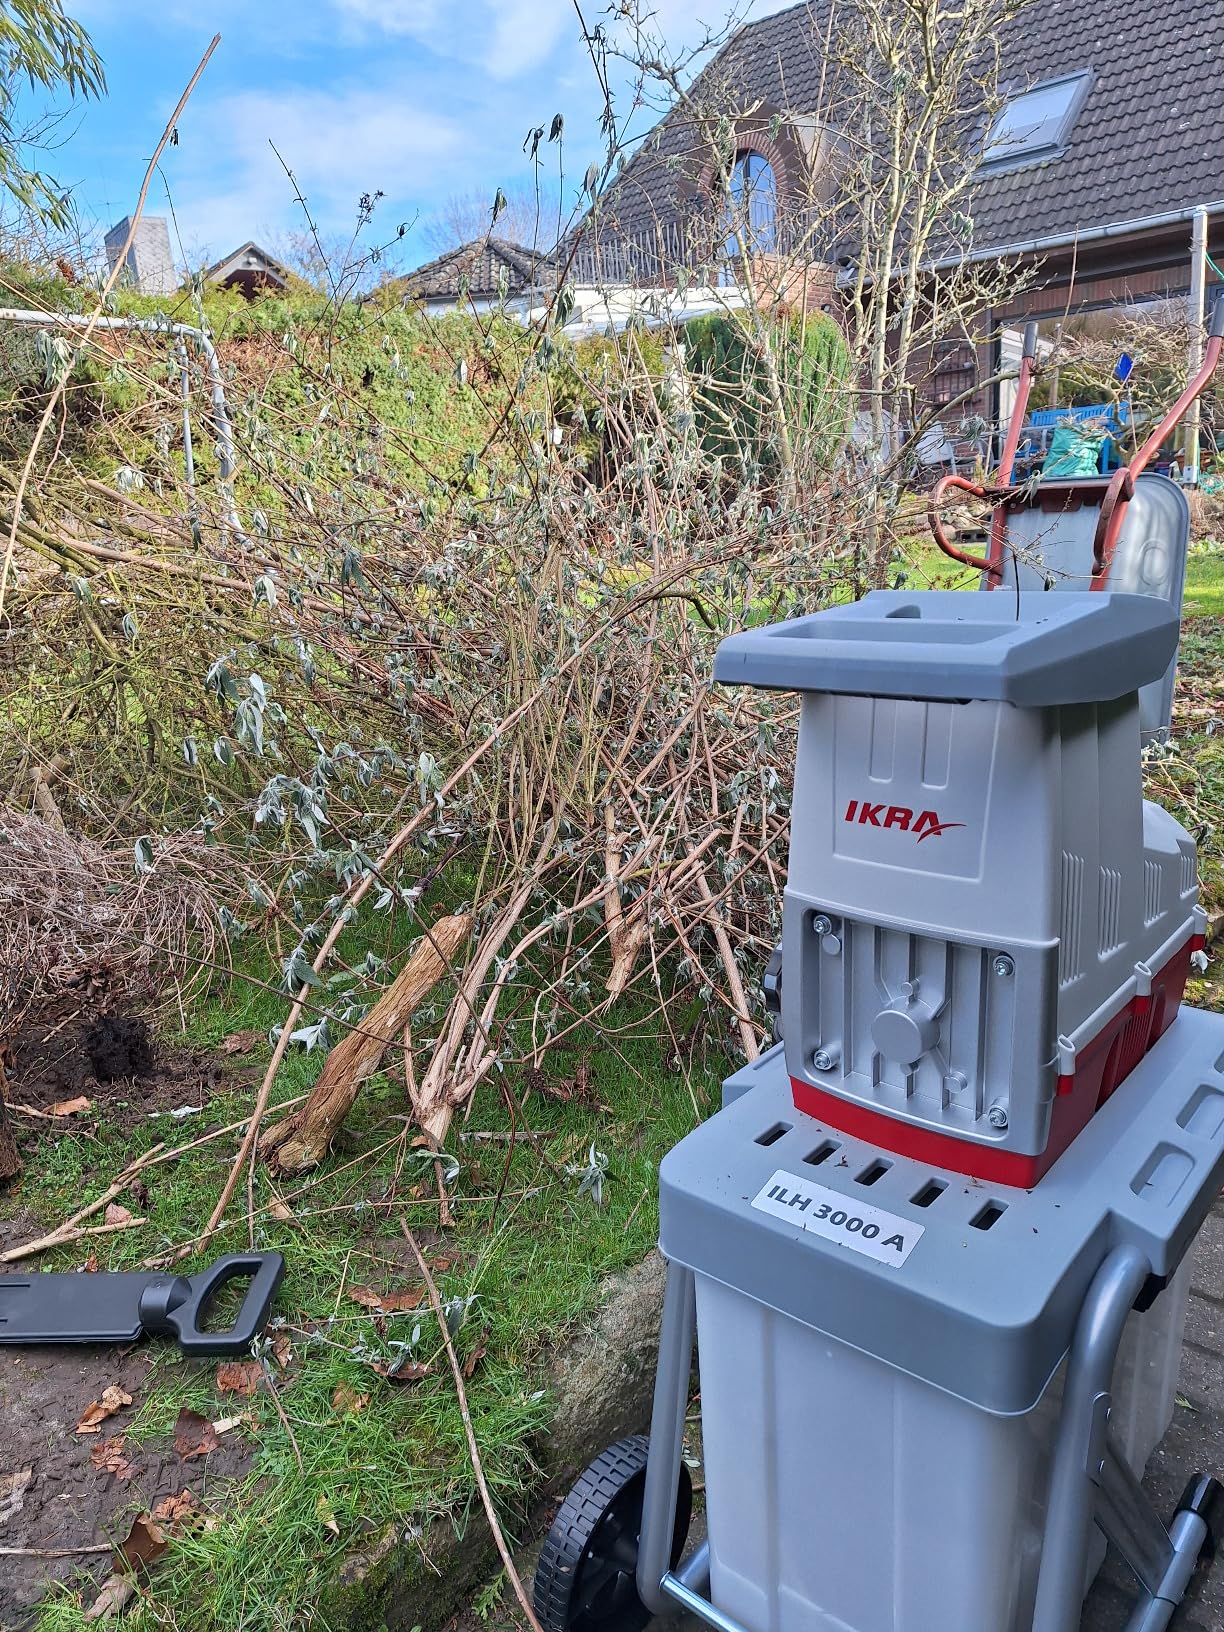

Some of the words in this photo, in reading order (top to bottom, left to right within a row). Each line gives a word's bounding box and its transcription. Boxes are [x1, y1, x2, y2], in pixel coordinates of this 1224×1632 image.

[844, 800, 967, 844] IKRA
[767, 1185, 813, 1212] ILH
[813, 1203, 880, 1239] 3000
[881, 1234, 905, 1252] A
